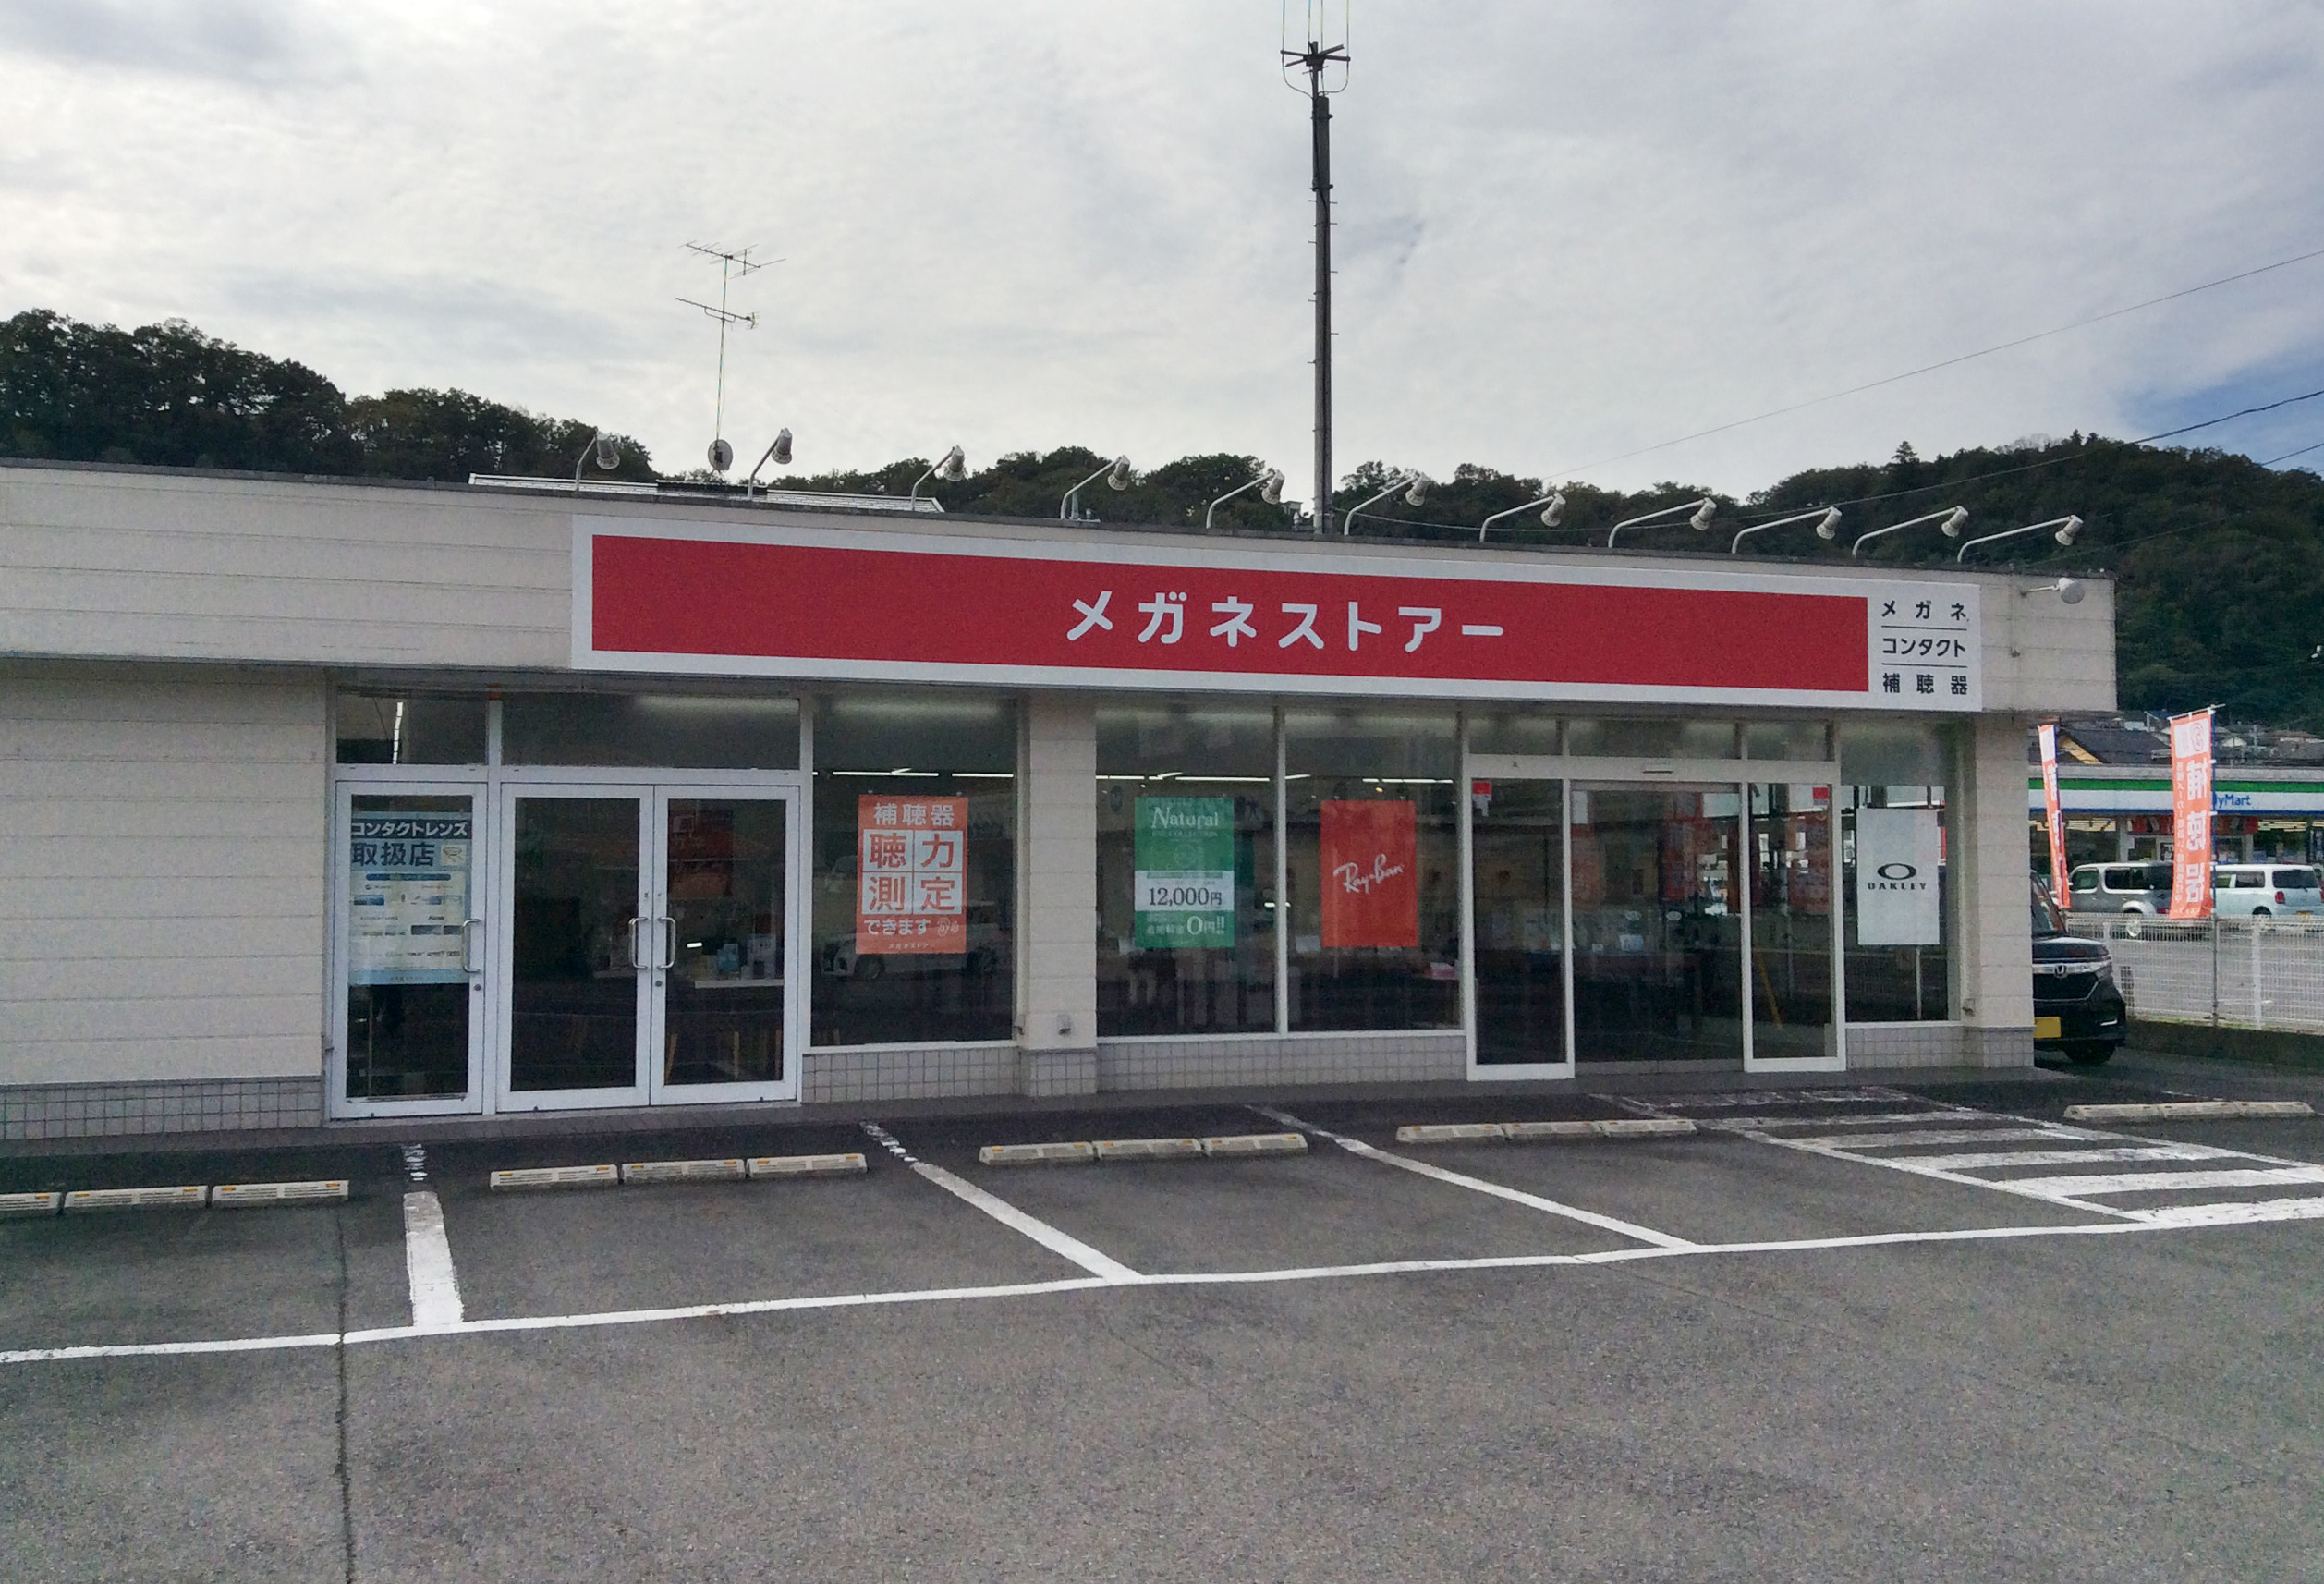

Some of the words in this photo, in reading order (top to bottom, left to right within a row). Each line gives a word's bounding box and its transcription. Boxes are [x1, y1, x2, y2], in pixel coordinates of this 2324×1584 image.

[1067, 590, 1503, 652] メガネストアー
[1881, 600, 1966, 621] メガネ
[1882, 638, 1966, 658] コンタクト
[1882, 672, 1968, 696] 補聴器
[873, 802, 955, 826] 補聴器
[1151, 806, 1219, 830] Natural
[351, 821, 468, 837] コンタクトレンズ
[351, 842, 435, 867] 取扱店
[869, 833, 955, 869] 聴力
[869, 876, 955, 911] 測定
[1150, 887, 1223, 908] 12,000円
[1868, 882, 1928, 891] OAKLEY
[864, 918, 932, 936] できます
